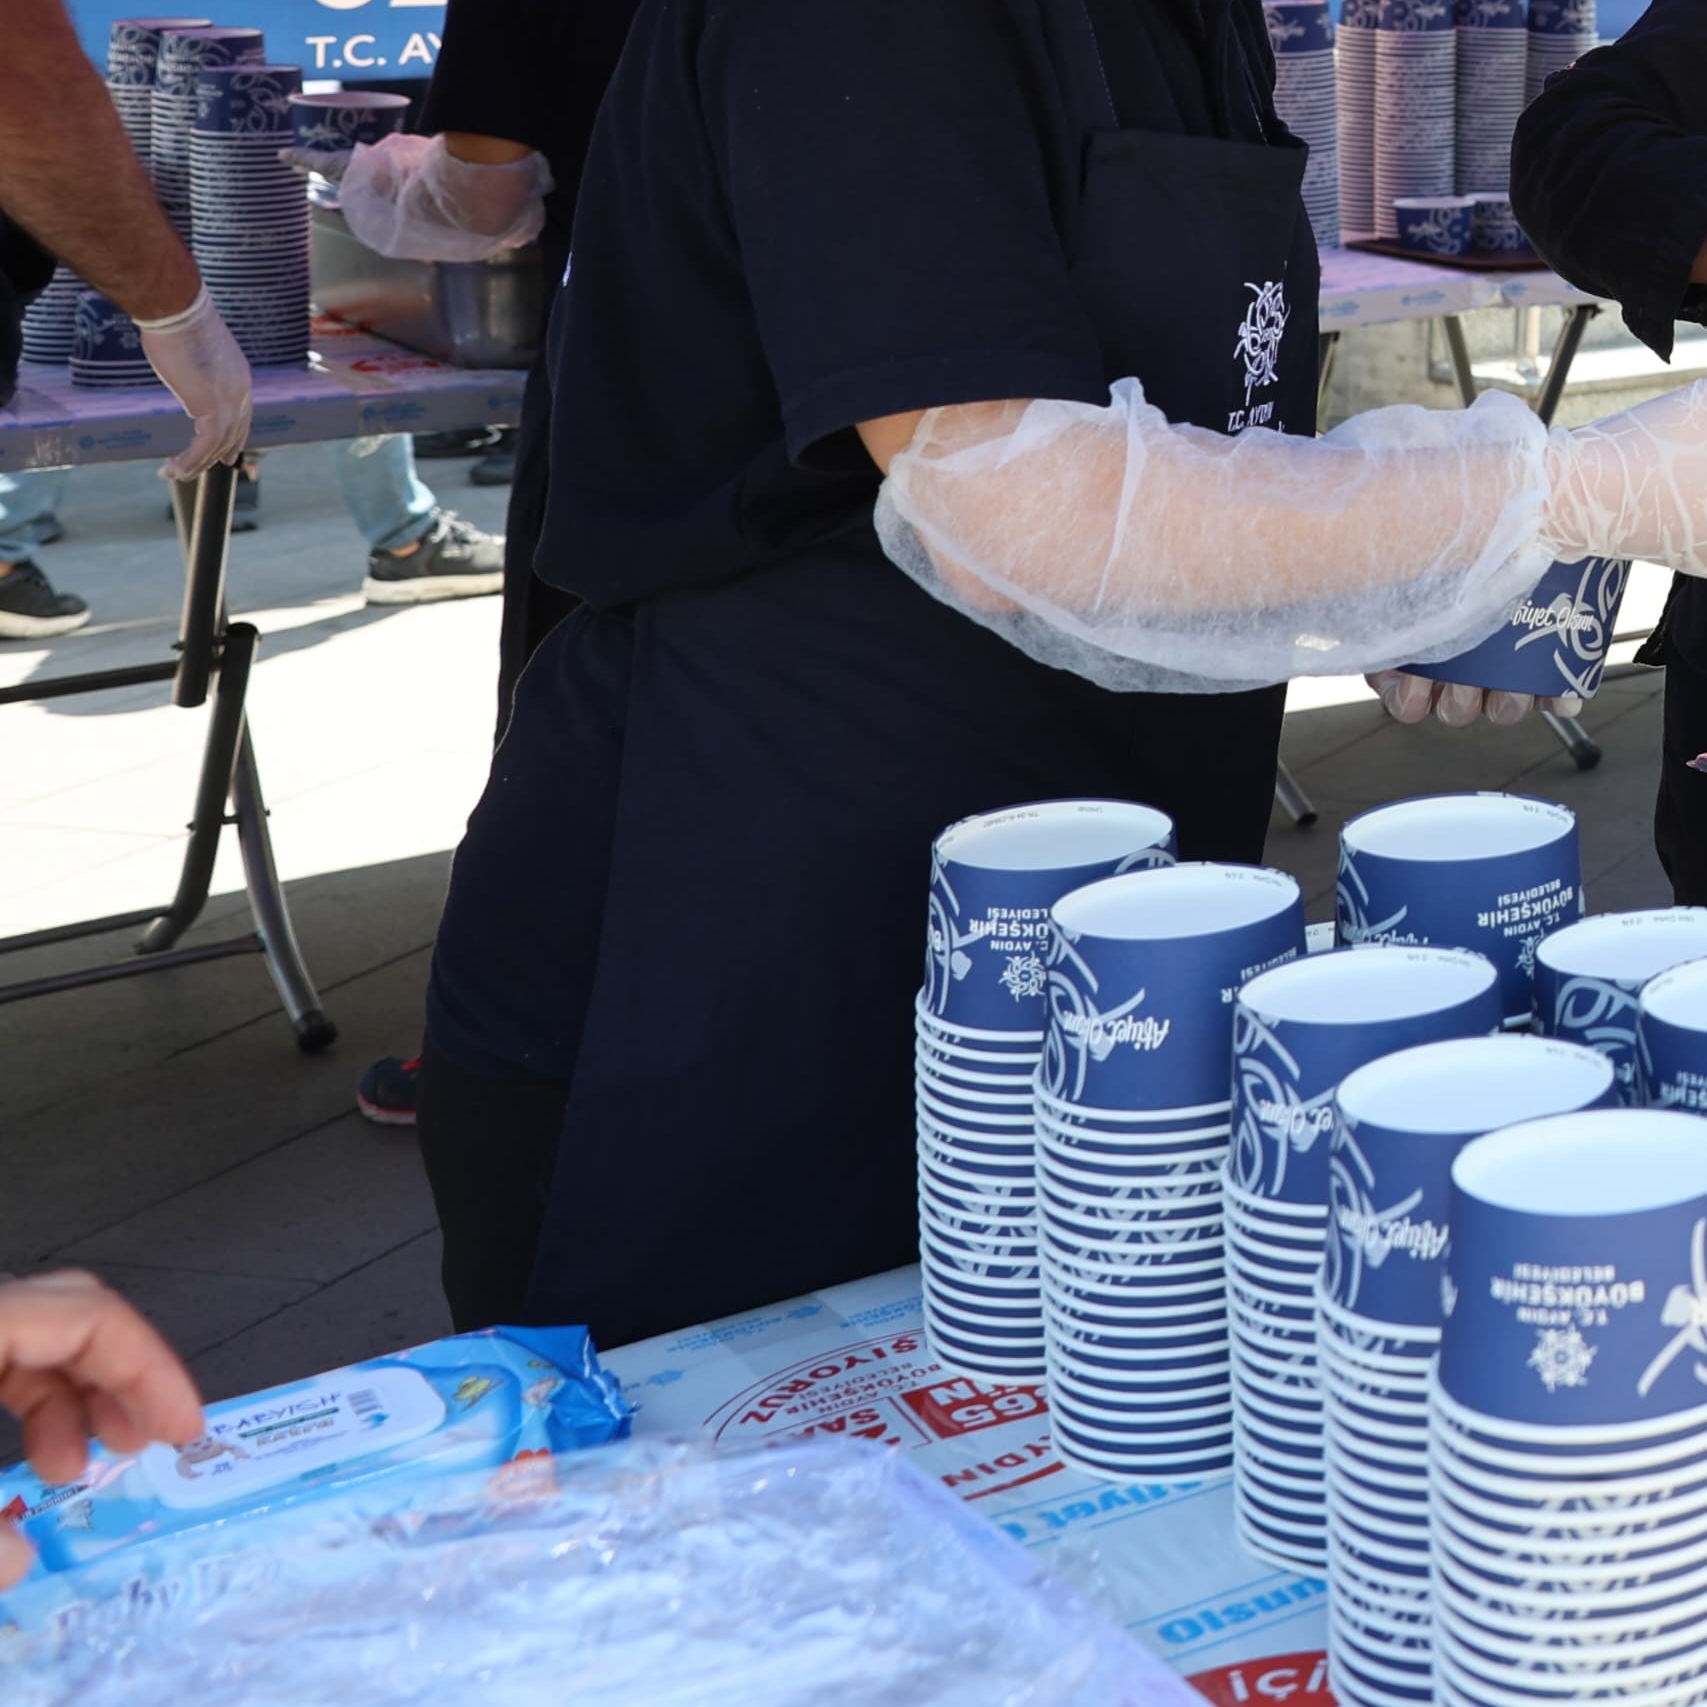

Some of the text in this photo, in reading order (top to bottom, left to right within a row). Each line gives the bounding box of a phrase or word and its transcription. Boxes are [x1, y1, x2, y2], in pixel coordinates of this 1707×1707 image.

[305, 34, 387, 69] T.C.
[1508, 598, 1554, 631] fiyet
[1477, 886, 1574, 929] BÜYÜKŞEHİR
[1498, 878, 1562, 908] BELEDİYESİ
[968, 918, 1050, 940] ÜKŞEHİR
[987, 906, 1049, 920] LEDİYESİ
[990, 940, 1032, 952] AYDIN
[1504, 922, 1541, 938] AYDIN
[1490, 1277, 1645, 1309] BÜYÜKŞEHİR
[738, 1336, 920, 1426] ŞIYORUZ
[941, 1435, 1051, 1489] YDIN
[1229, 1660, 1328, 1702] İÇİ
